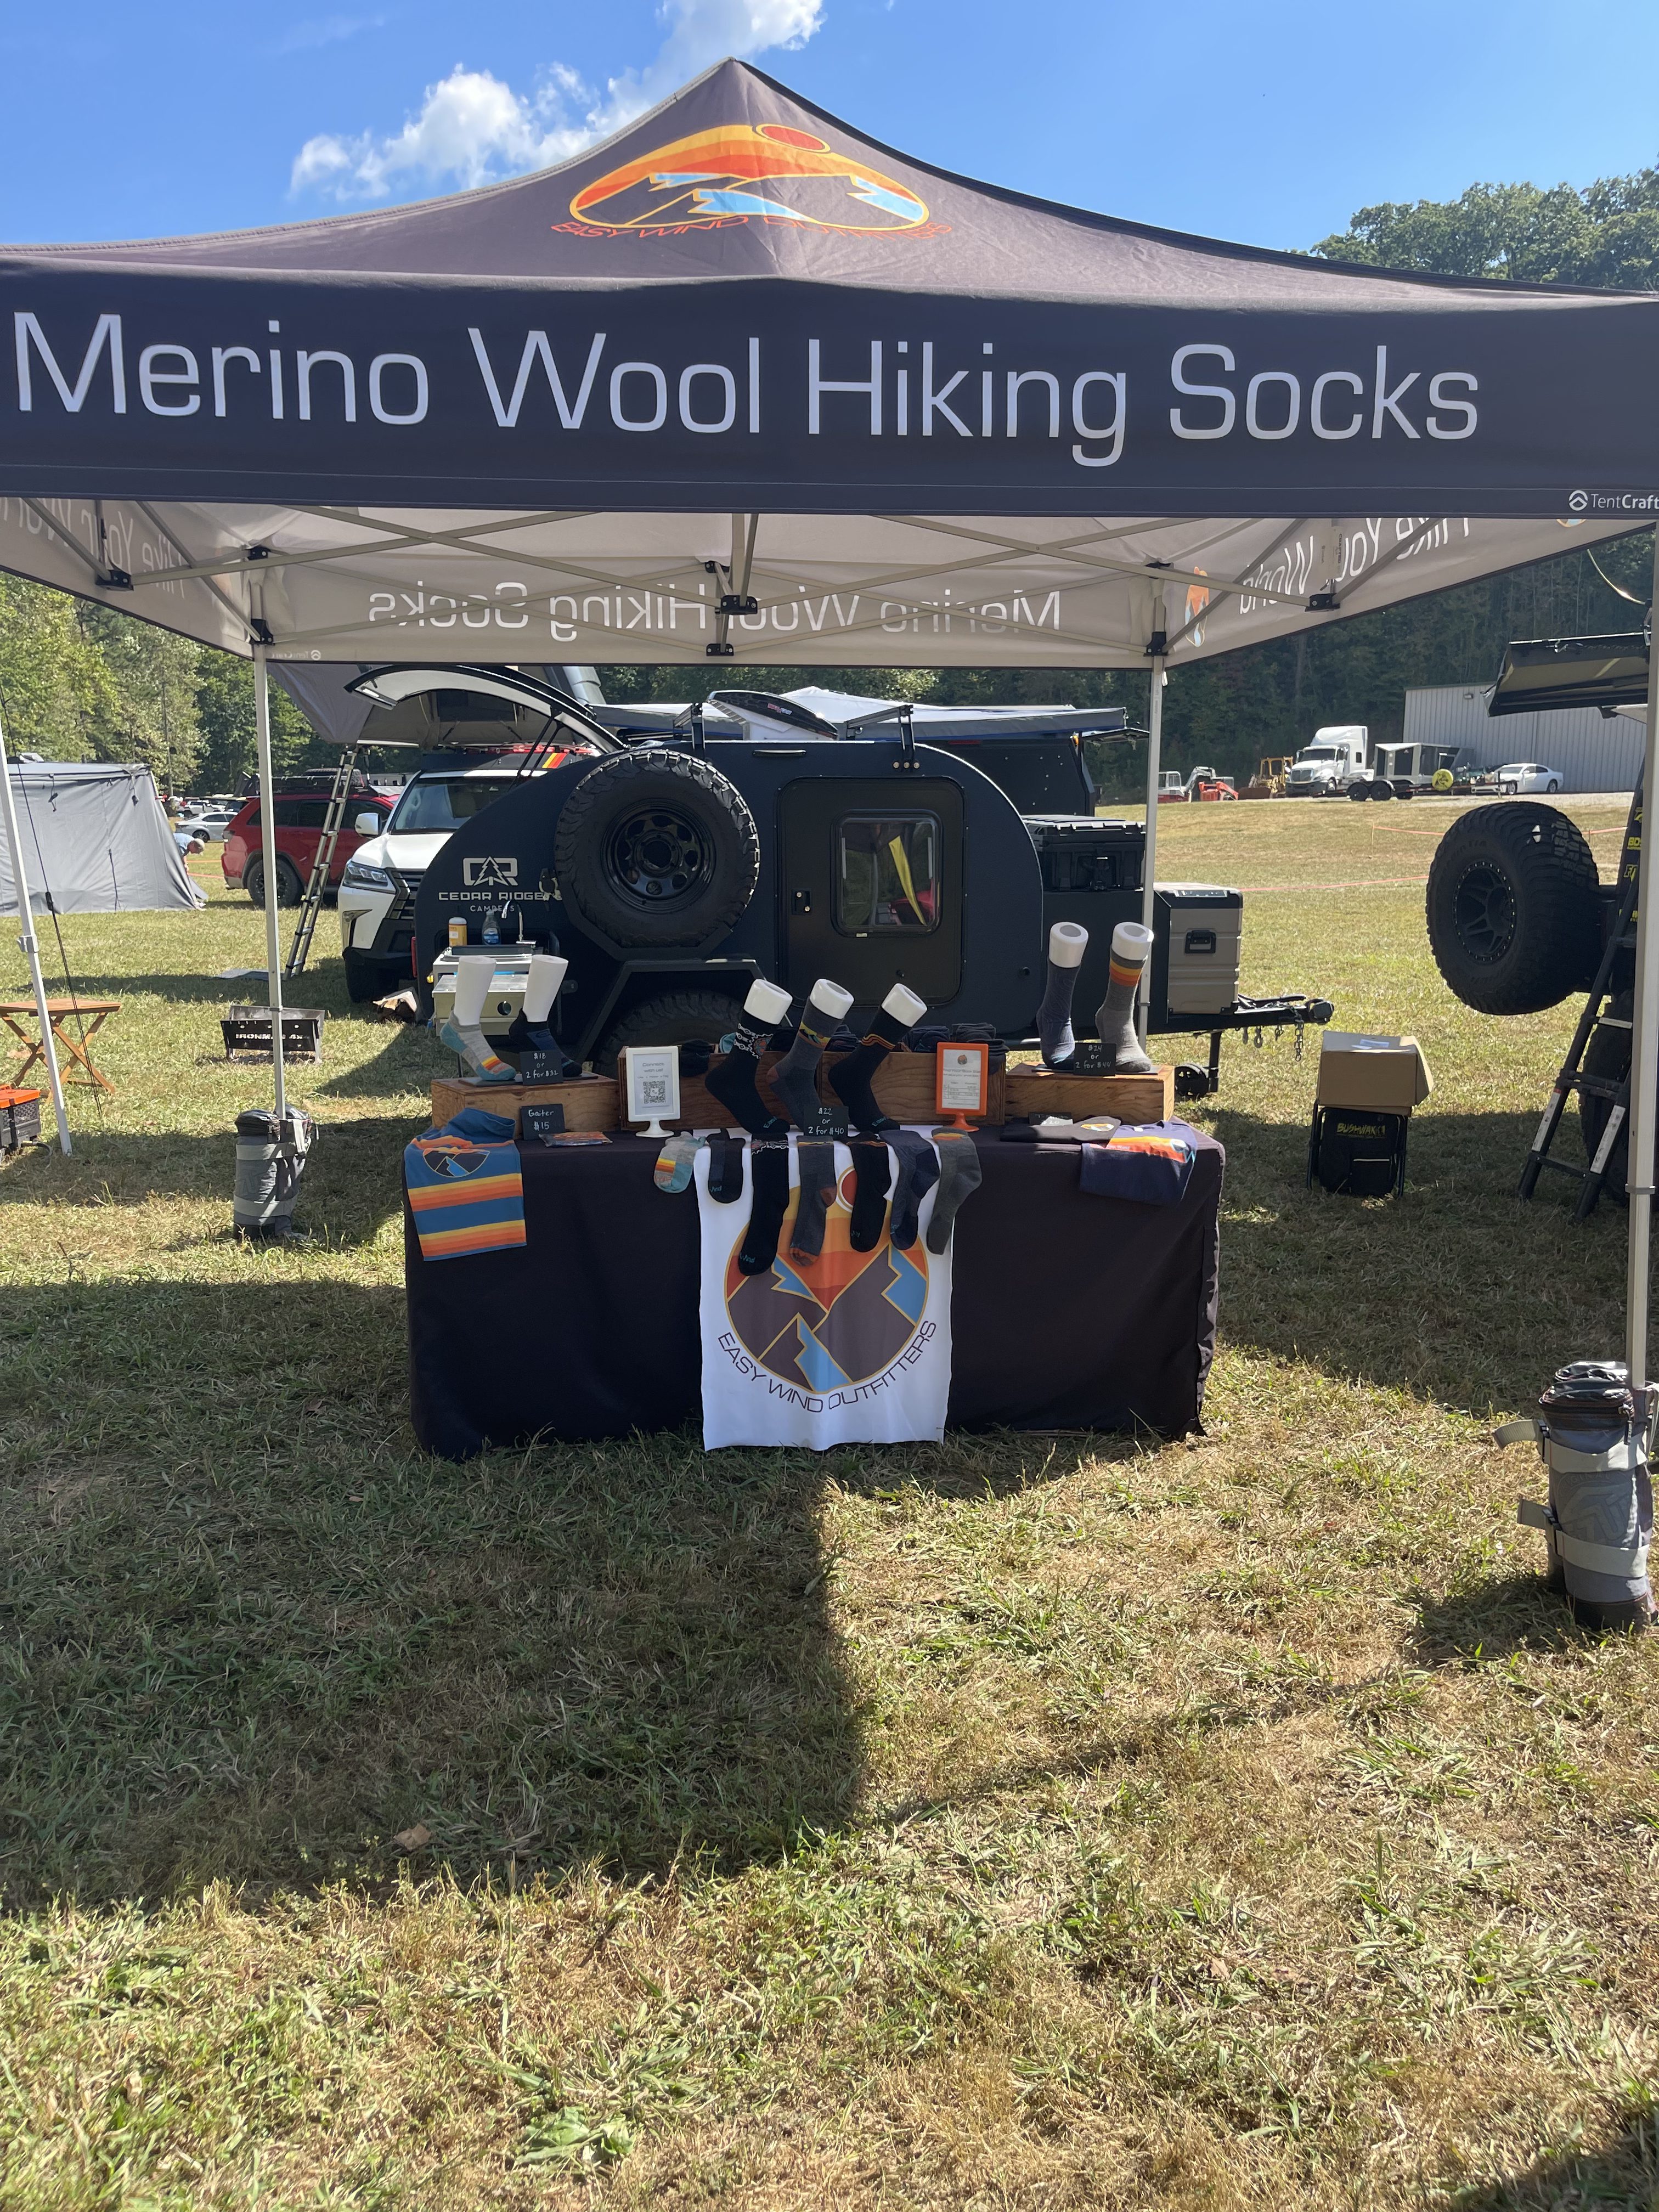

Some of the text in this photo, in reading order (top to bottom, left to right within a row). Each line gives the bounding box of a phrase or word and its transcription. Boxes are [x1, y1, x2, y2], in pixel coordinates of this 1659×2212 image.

[551, 221, 634, 238] EASY
[639, 216, 749, 238] WIND
[14, 311, 1479, 467] Merino Wool Hiking Socks
[1591, 494, 1659, 509] TentCraft
[438, 892, 544, 901] CEDAR RIDGE
[1084, 1060, 1095, 1069] for
[533, 1069, 545, 1079] for
[528, 1109, 554, 1117] Gaiter
[533, 1121, 550, 1131] $15
[816, 1125, 828, 1135] for
[718, 1321, 936, 1413] EASY WIND OUTFITTERS
